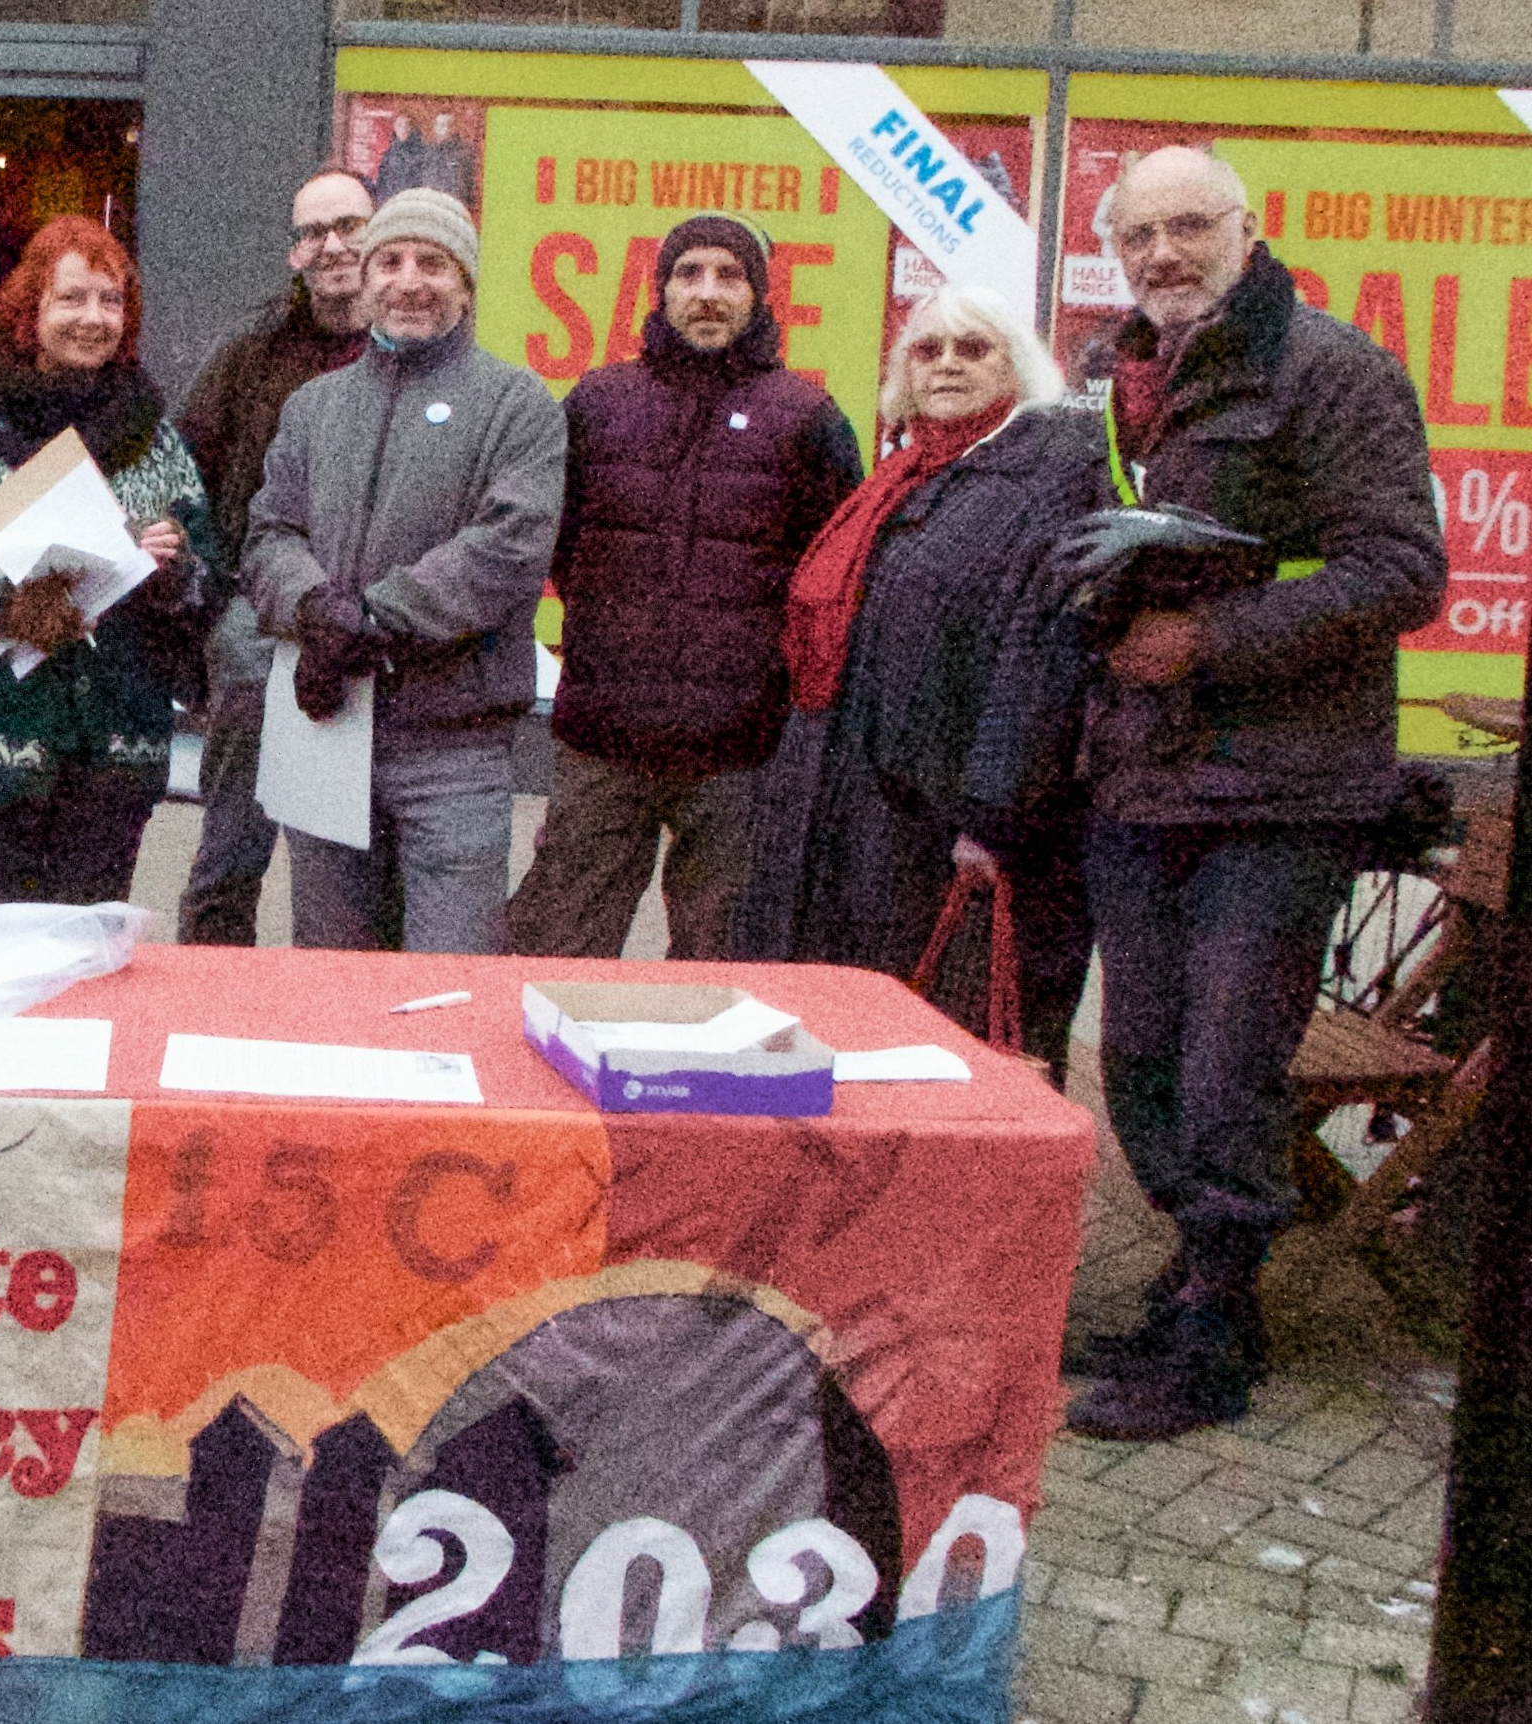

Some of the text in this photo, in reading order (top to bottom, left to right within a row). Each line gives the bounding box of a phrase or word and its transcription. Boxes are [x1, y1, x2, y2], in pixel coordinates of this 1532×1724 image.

[575, 158, 802, 211] BIG WINTER
[848, 136, 961, 255] REDUCTIONS
[871, 109, 986, 235] FINAL
[1305, 190, 1371, 240] BIG
[903, 273, 948, 287] PRIC
[1071, 282, 1118, 296] PRICE
[1072, 266, 1118, 281] HALF
[525, 232, 835, 385] SAE
[1448, 599, 1527, 637] Off
